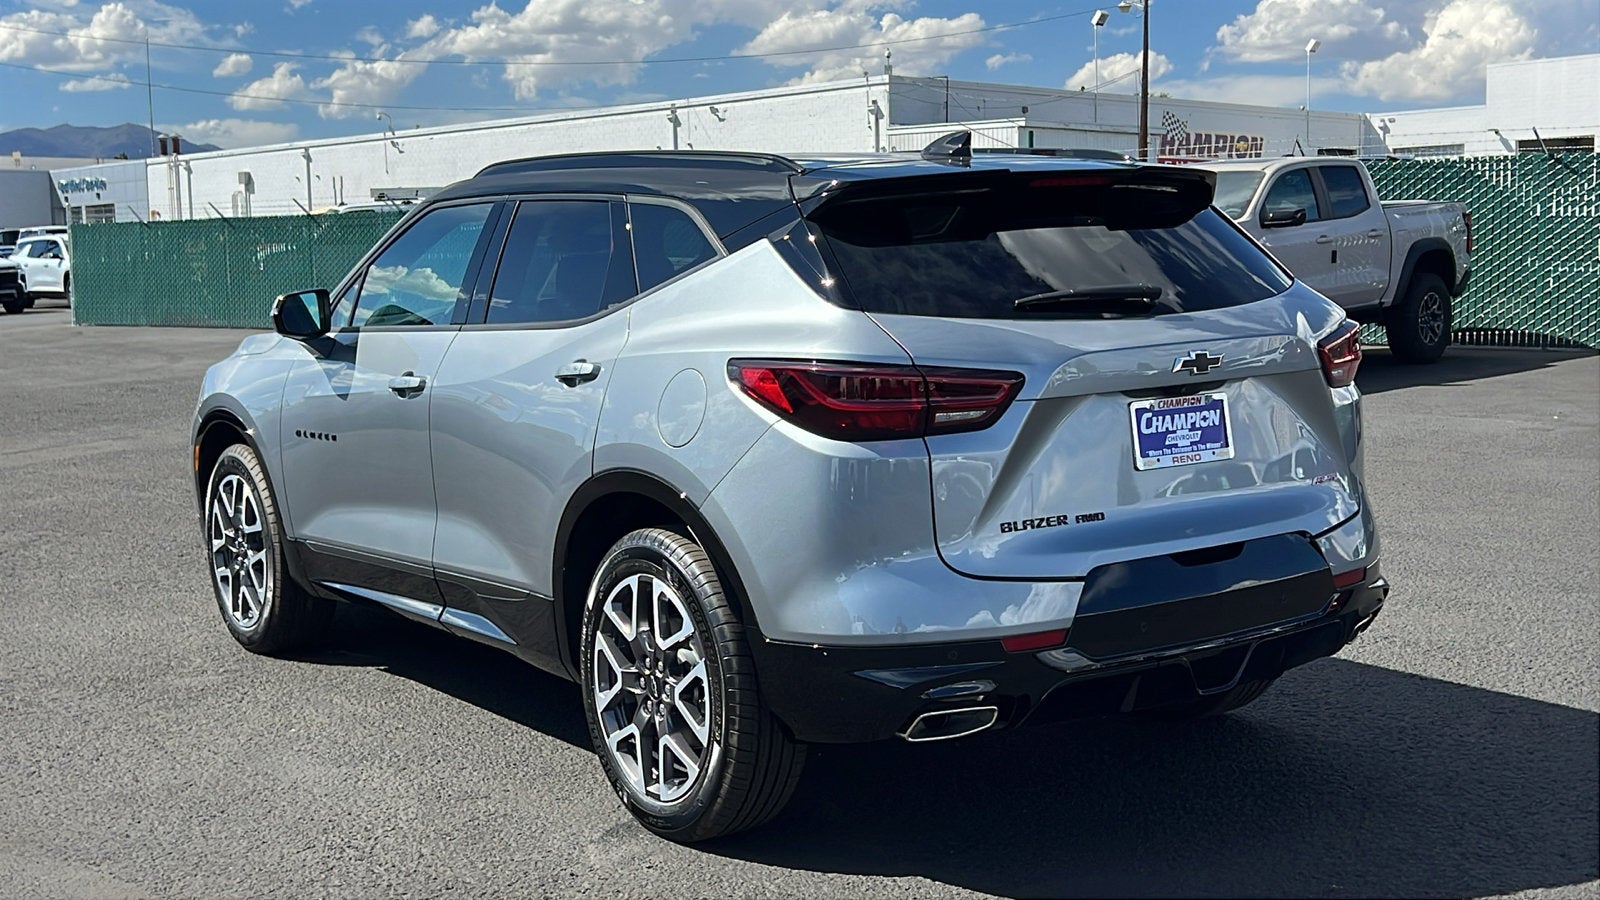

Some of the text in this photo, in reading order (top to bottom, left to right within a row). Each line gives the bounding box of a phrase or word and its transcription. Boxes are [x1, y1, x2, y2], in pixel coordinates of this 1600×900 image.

[1157, 396, 1202, 409] CHAMPION
[1140, 409, 1220, 434] CHAMPION
[1167, 432, 1200, 443] CHEVROLET
[1172, 453, 1202, 464] RENO
[1000, 511, 1105, 533] BLAZER AWD
